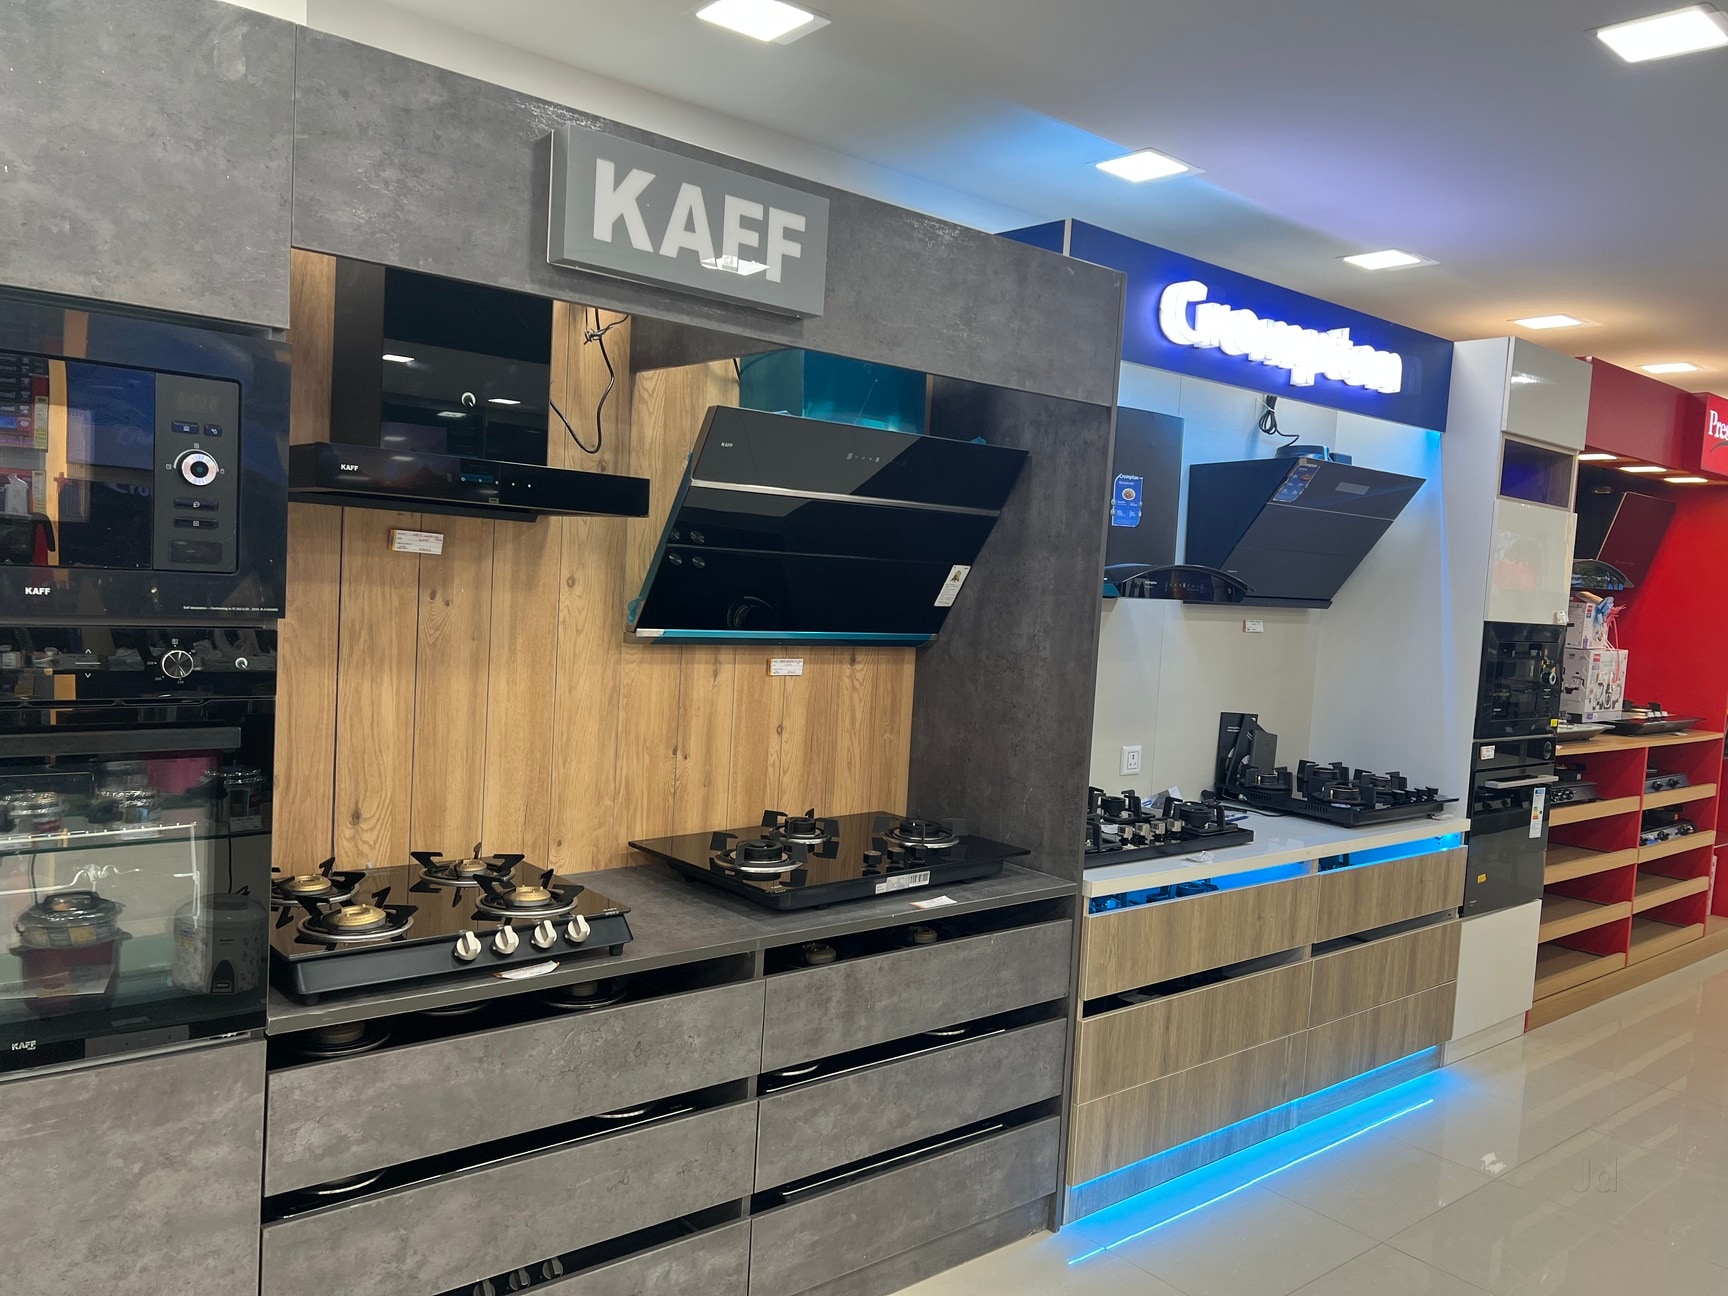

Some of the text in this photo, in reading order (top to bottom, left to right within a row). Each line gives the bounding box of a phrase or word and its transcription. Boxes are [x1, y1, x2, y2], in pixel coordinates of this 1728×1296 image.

[593, 158, 806, 283] KAFF
[25, 587, 51, 596] KAFF
[11, 1040, 37, 1051] KAFF
